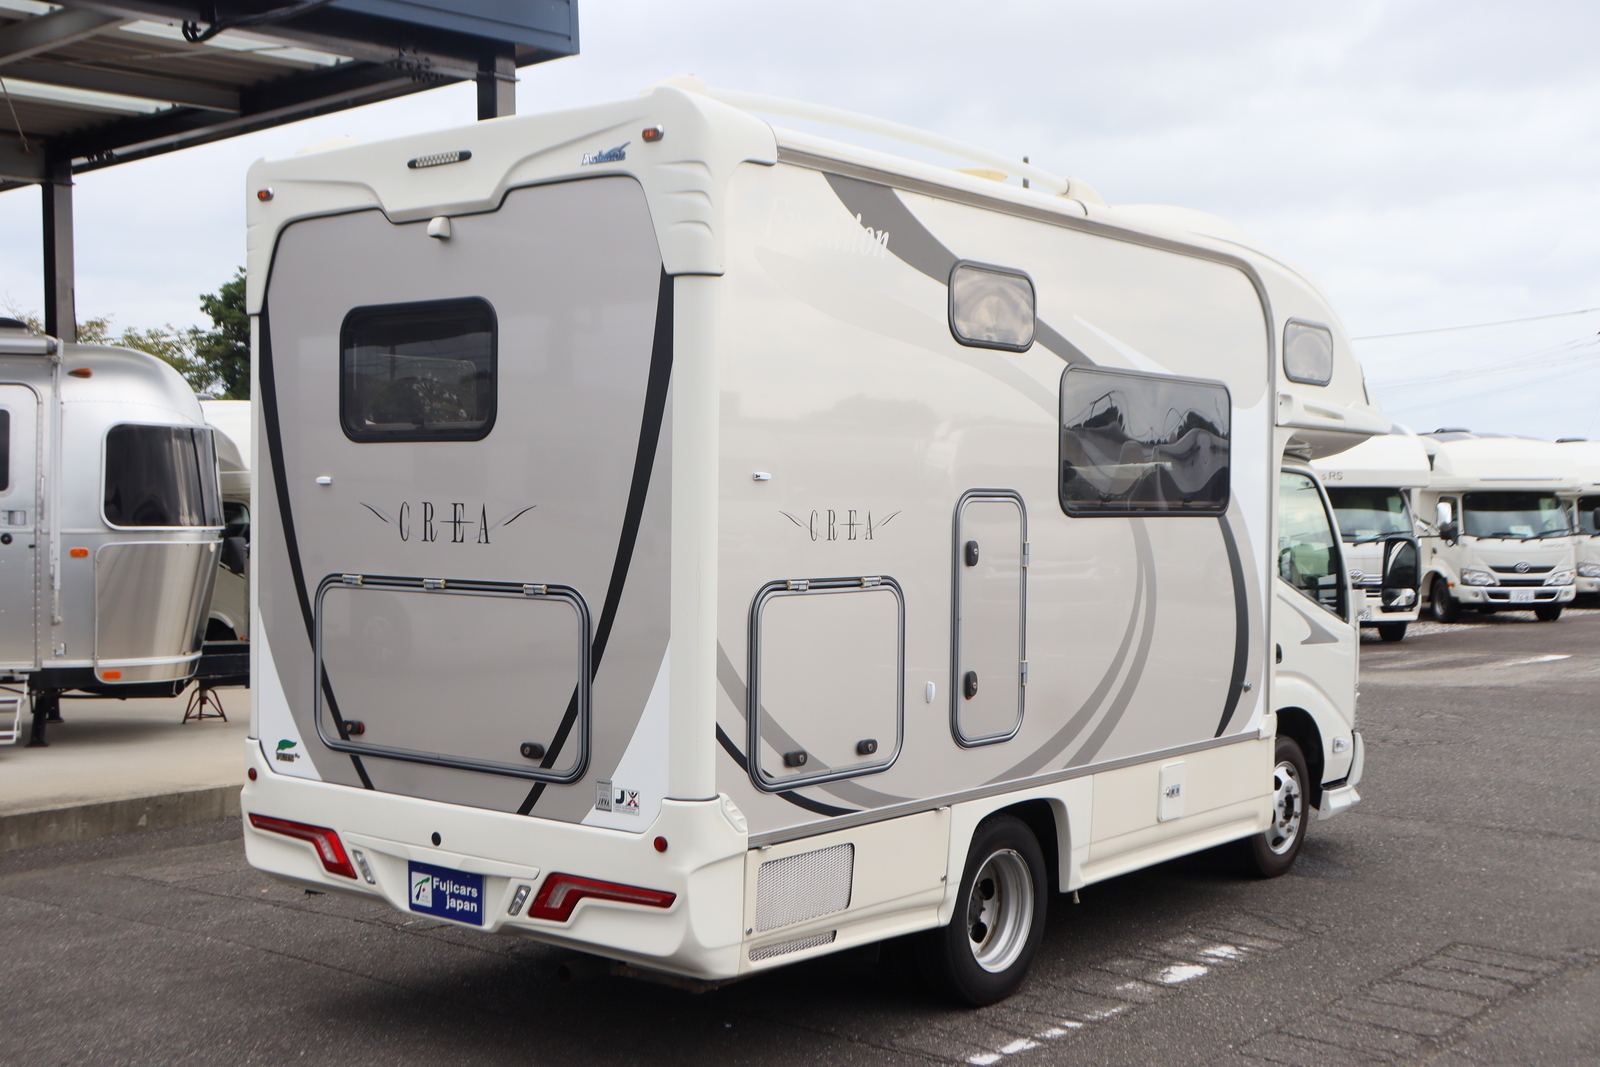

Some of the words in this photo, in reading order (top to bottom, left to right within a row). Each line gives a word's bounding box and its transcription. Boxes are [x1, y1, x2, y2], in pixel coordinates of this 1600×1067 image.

[400, 501, 490, 544] CREA
[809, 509, 873, 541] CREA
[433, 877, 478, 898] Fujicars
[445, 894, 478, 913] japan
